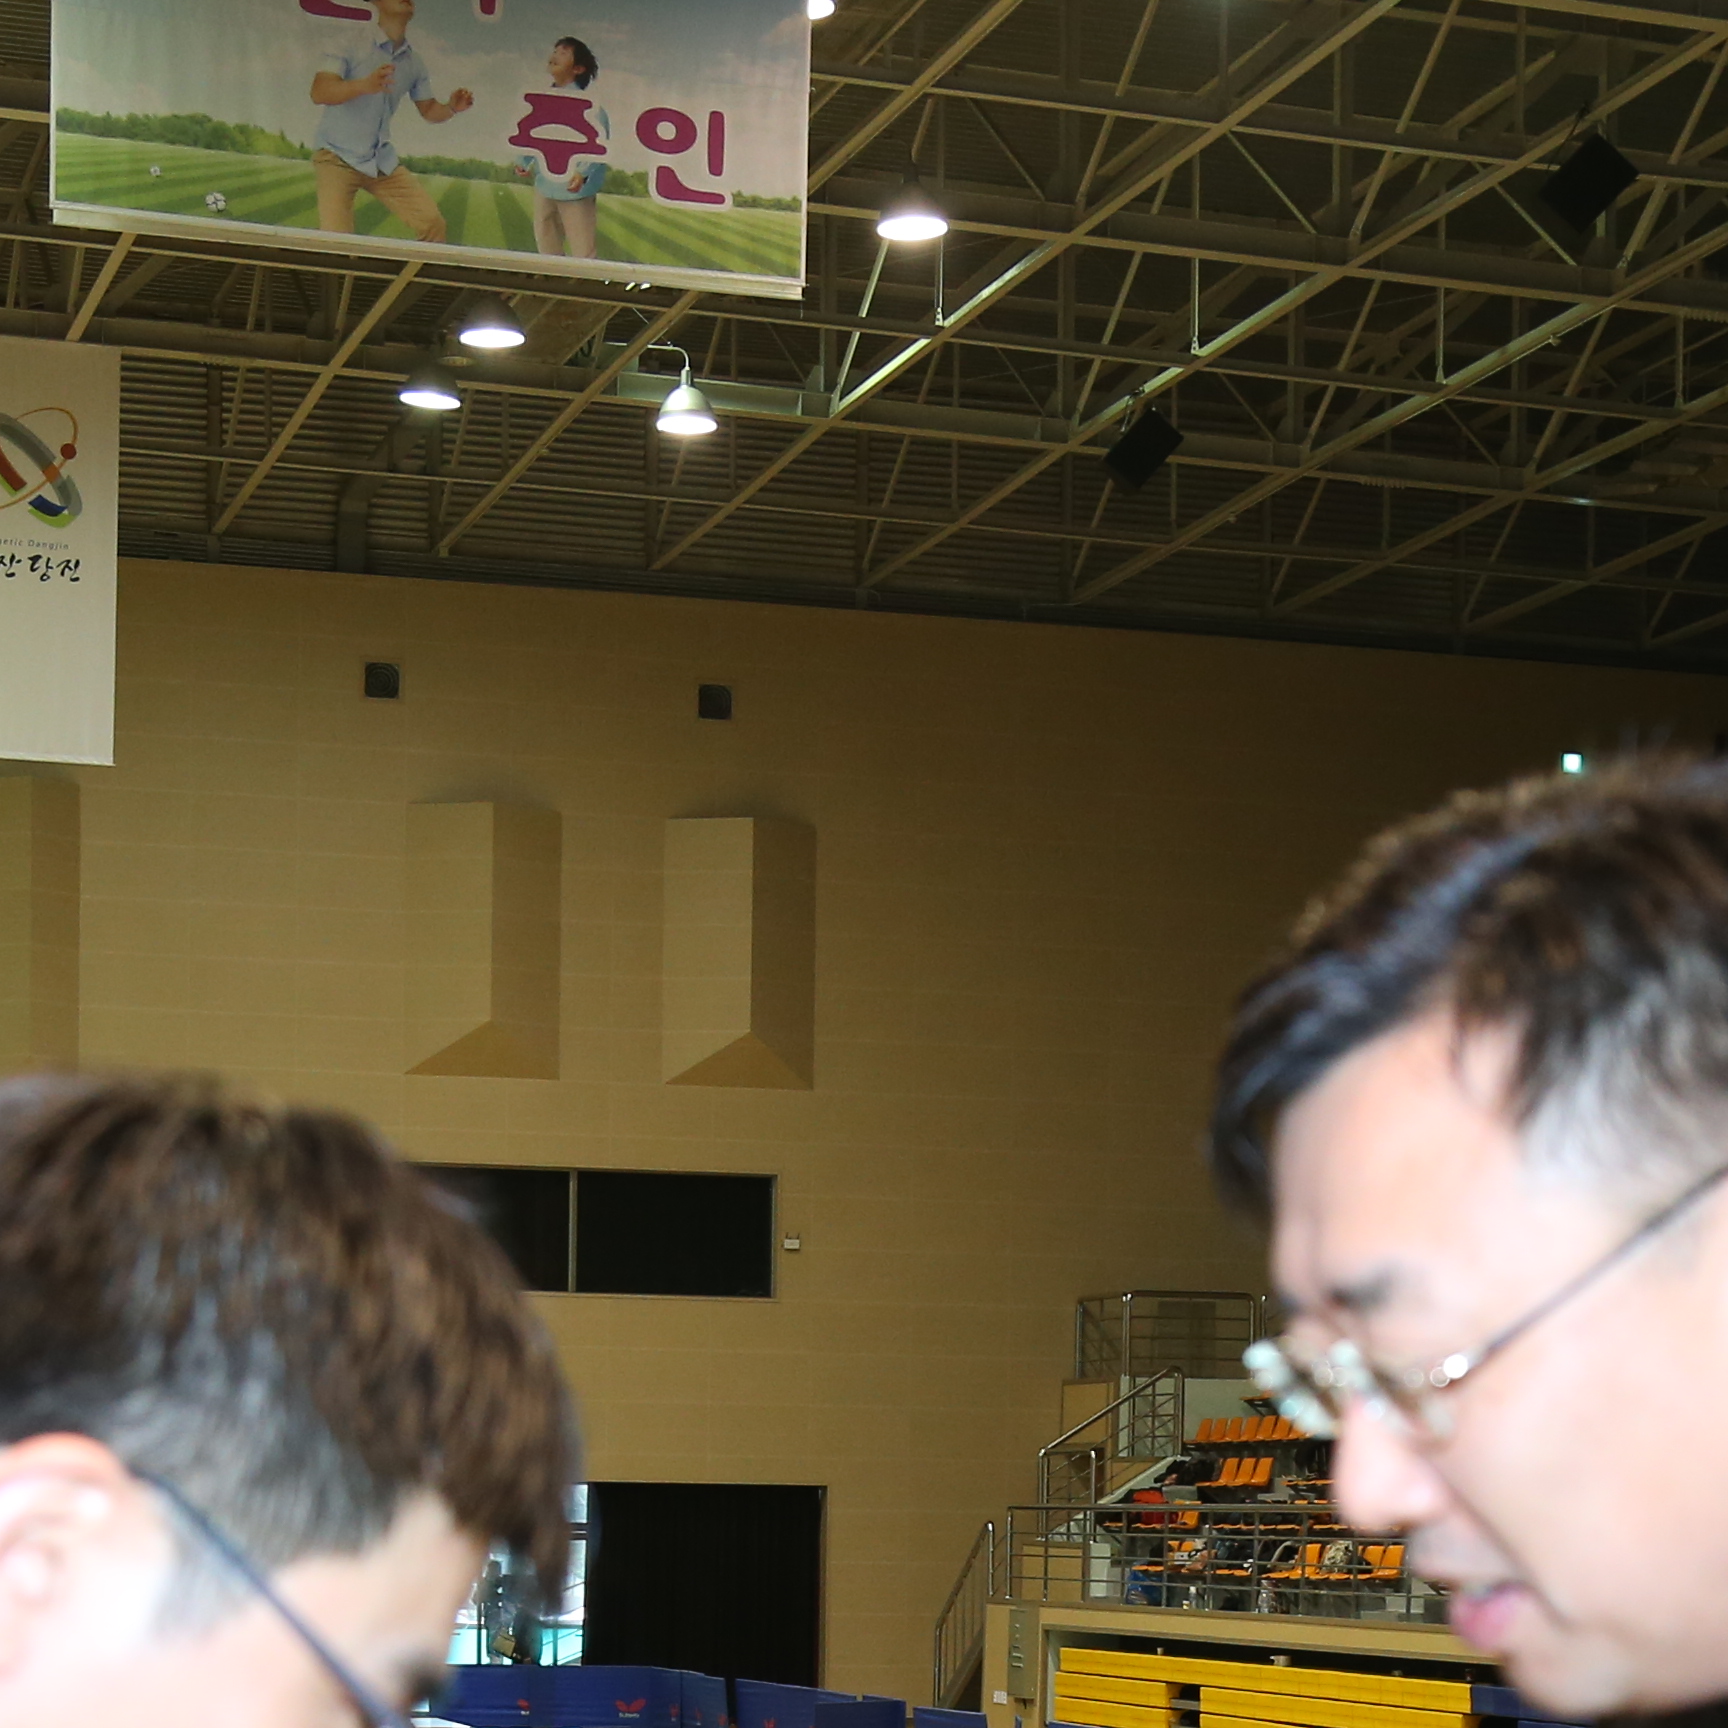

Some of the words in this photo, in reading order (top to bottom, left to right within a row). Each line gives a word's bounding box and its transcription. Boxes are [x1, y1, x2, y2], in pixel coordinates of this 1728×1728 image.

[508, 92, 728, 205] 주인
[27, 539, 70, 550] Dangjin
[27, 554, 81, 582] 당진
